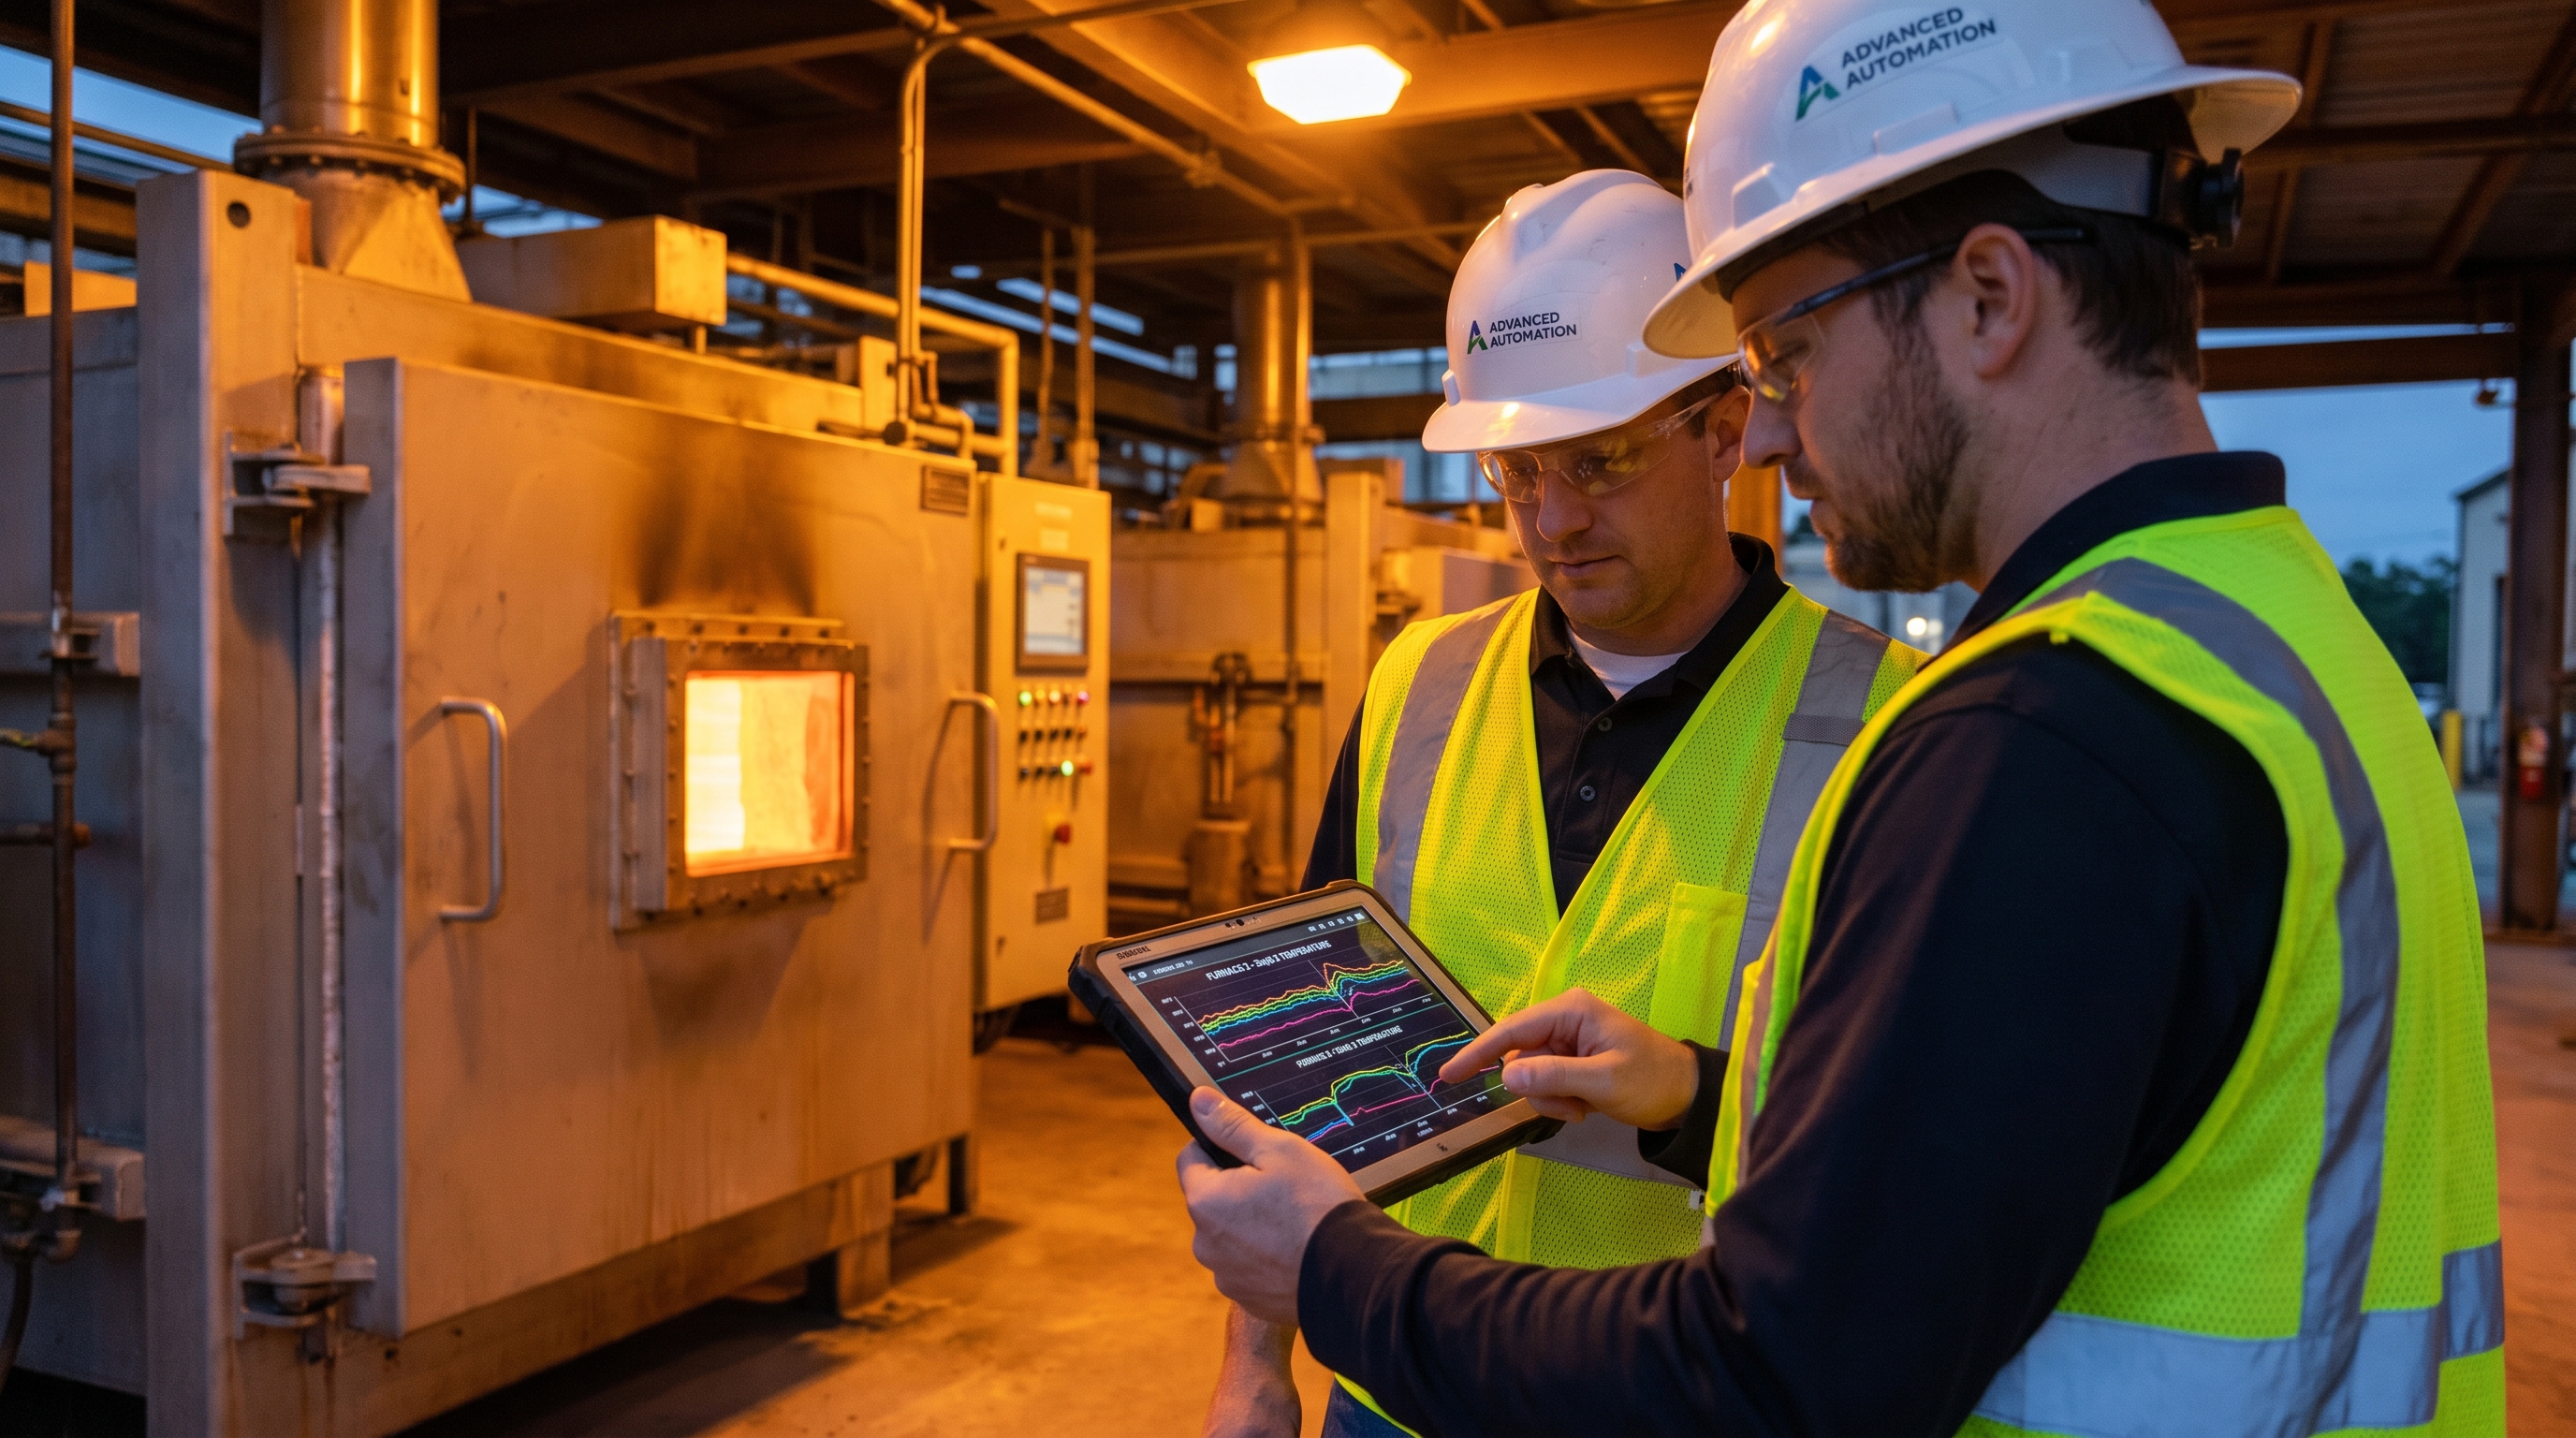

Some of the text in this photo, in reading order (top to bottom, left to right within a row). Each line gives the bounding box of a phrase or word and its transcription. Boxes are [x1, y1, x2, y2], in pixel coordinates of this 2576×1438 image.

[1841, 7, 1964, 68] ADVANCED
[1846, 18, 1997, 90] AUTOMATION
[1489, 312, 1559, 333] ADVANCED
[1490, 324, 1577, 348] AUTOMATION
